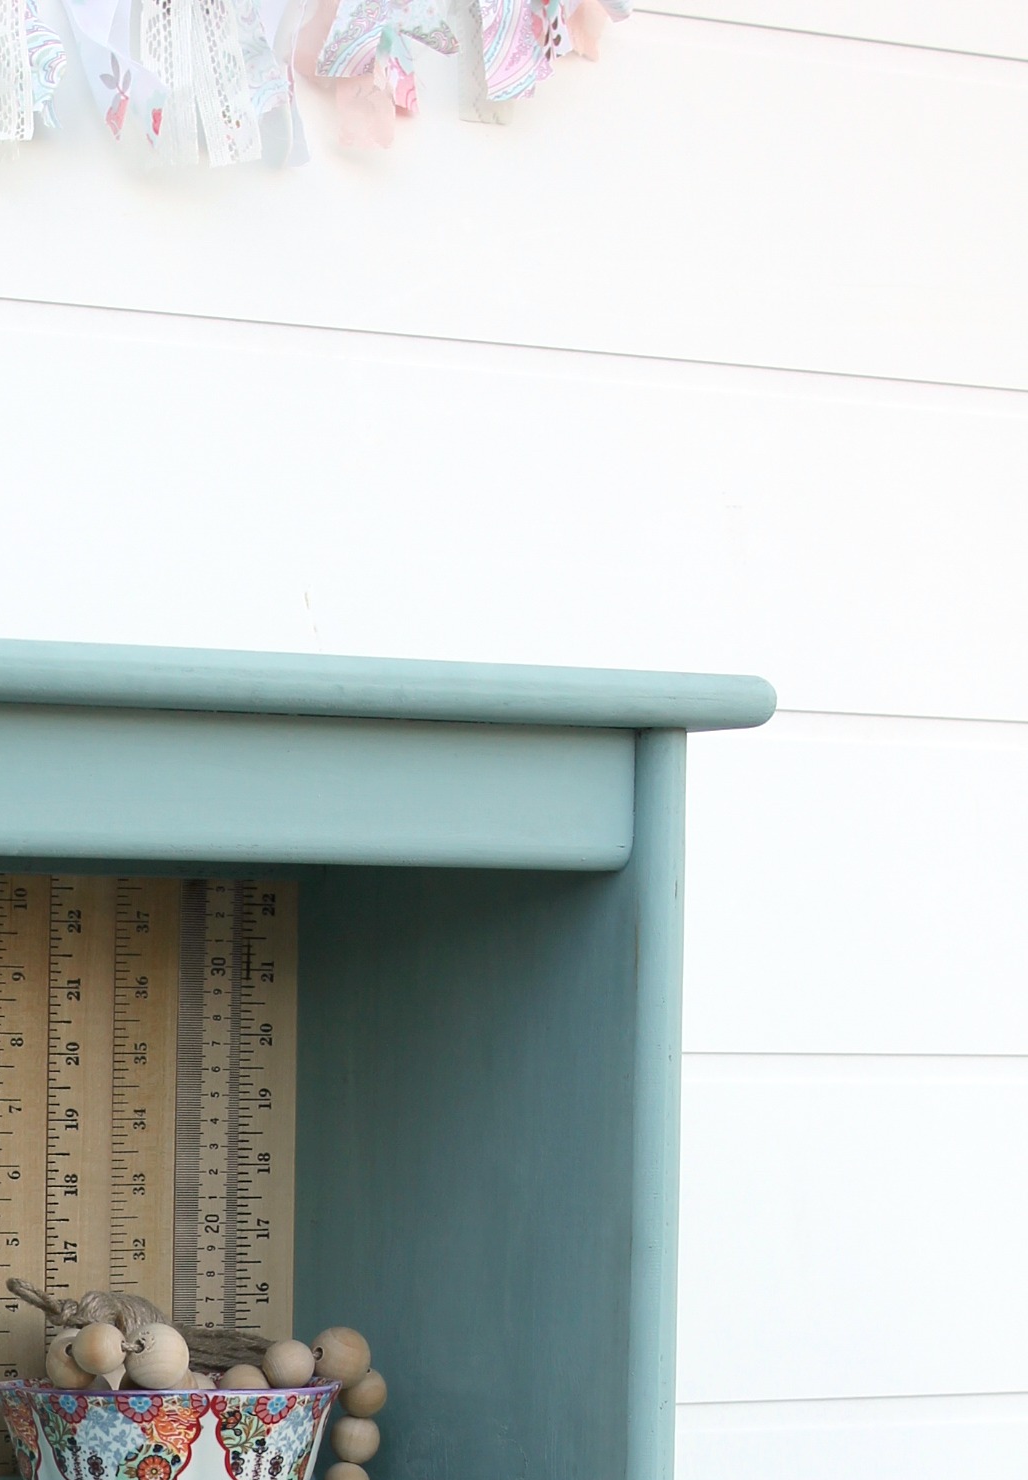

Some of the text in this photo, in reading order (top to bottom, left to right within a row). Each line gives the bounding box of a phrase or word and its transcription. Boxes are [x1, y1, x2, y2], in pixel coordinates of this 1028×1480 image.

[4, 888, 28, 1378] 3 4 5 6 7 8 9 10
[64, 909, 82, 1263] 17 18 19 20 21 22
[133, 911, 150, 1260] 32 33 34 35 36 37
[211, 958, 226, 976] 30
[256, 894, 276, 1304] 16 17 18 19 20 21 22
[204, 1214, 220, 1233] 20
